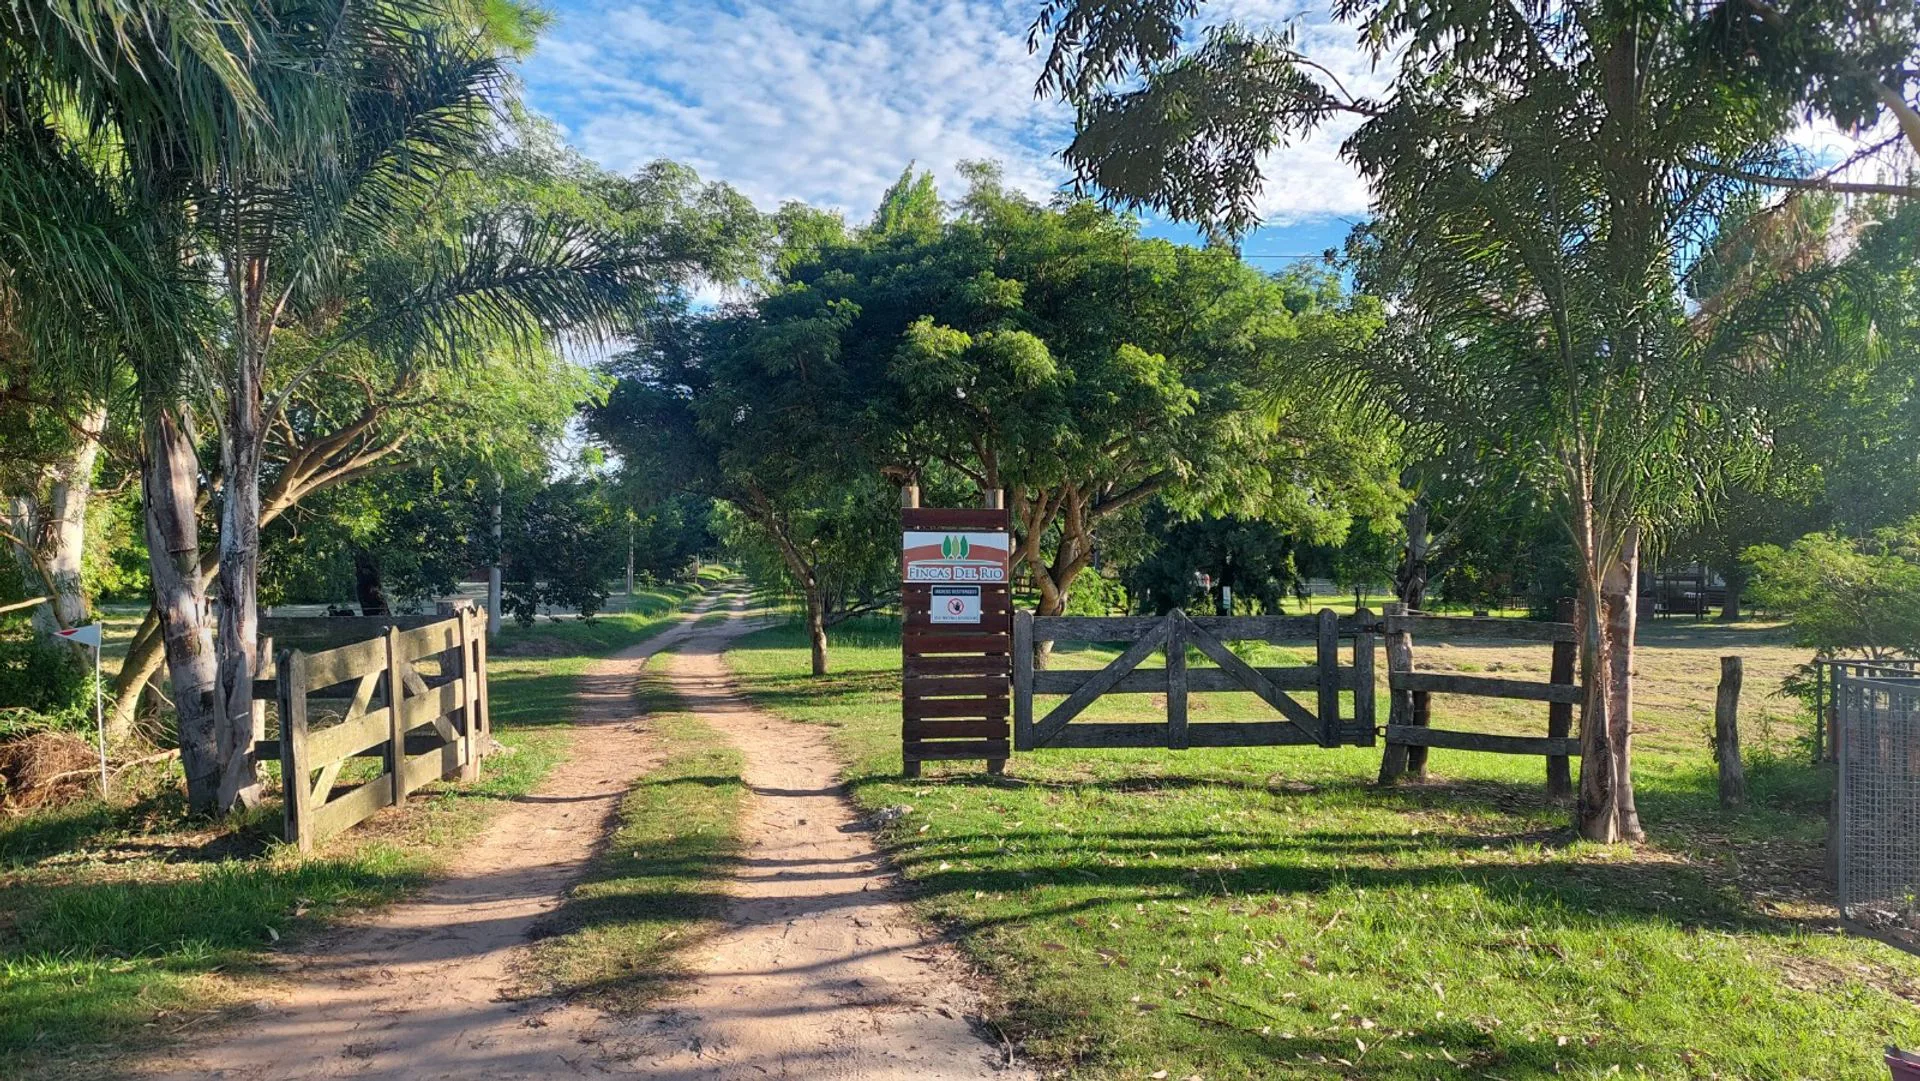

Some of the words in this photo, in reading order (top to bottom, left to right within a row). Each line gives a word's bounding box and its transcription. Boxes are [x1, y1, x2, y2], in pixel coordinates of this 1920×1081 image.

[909, 567, 950, 579] FINCAS
[955, 567, 977, 579] DEL
[981, 567, 1002, 579] RIO
